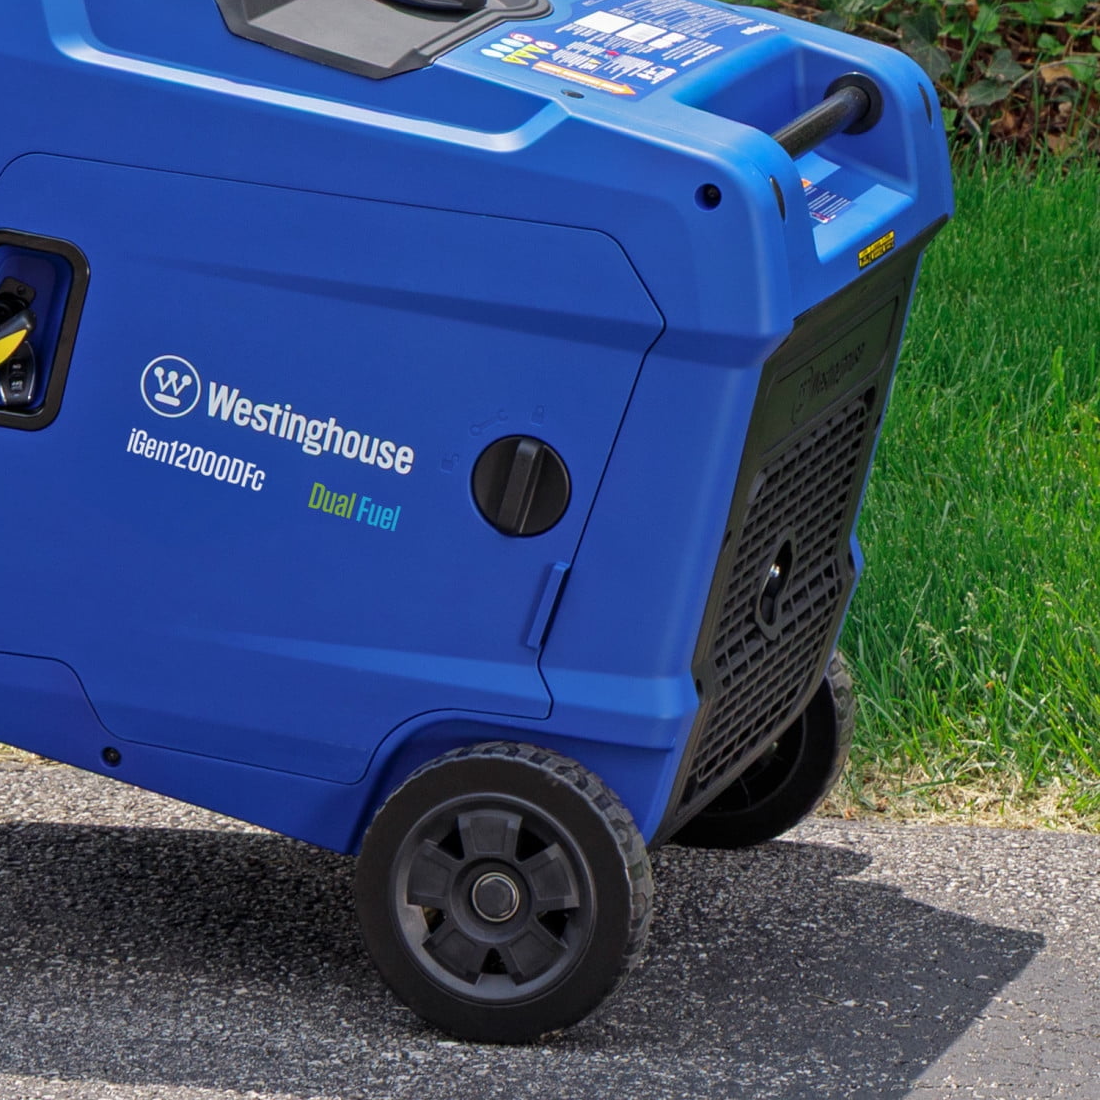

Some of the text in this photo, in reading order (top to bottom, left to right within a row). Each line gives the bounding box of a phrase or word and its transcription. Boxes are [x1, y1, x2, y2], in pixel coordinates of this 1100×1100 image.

[126, 427, 266, 492] iGen12000DFc
[207, 381, 415, 475] Westinghouse
[308, 481, 402, 532] Dual Fuel
